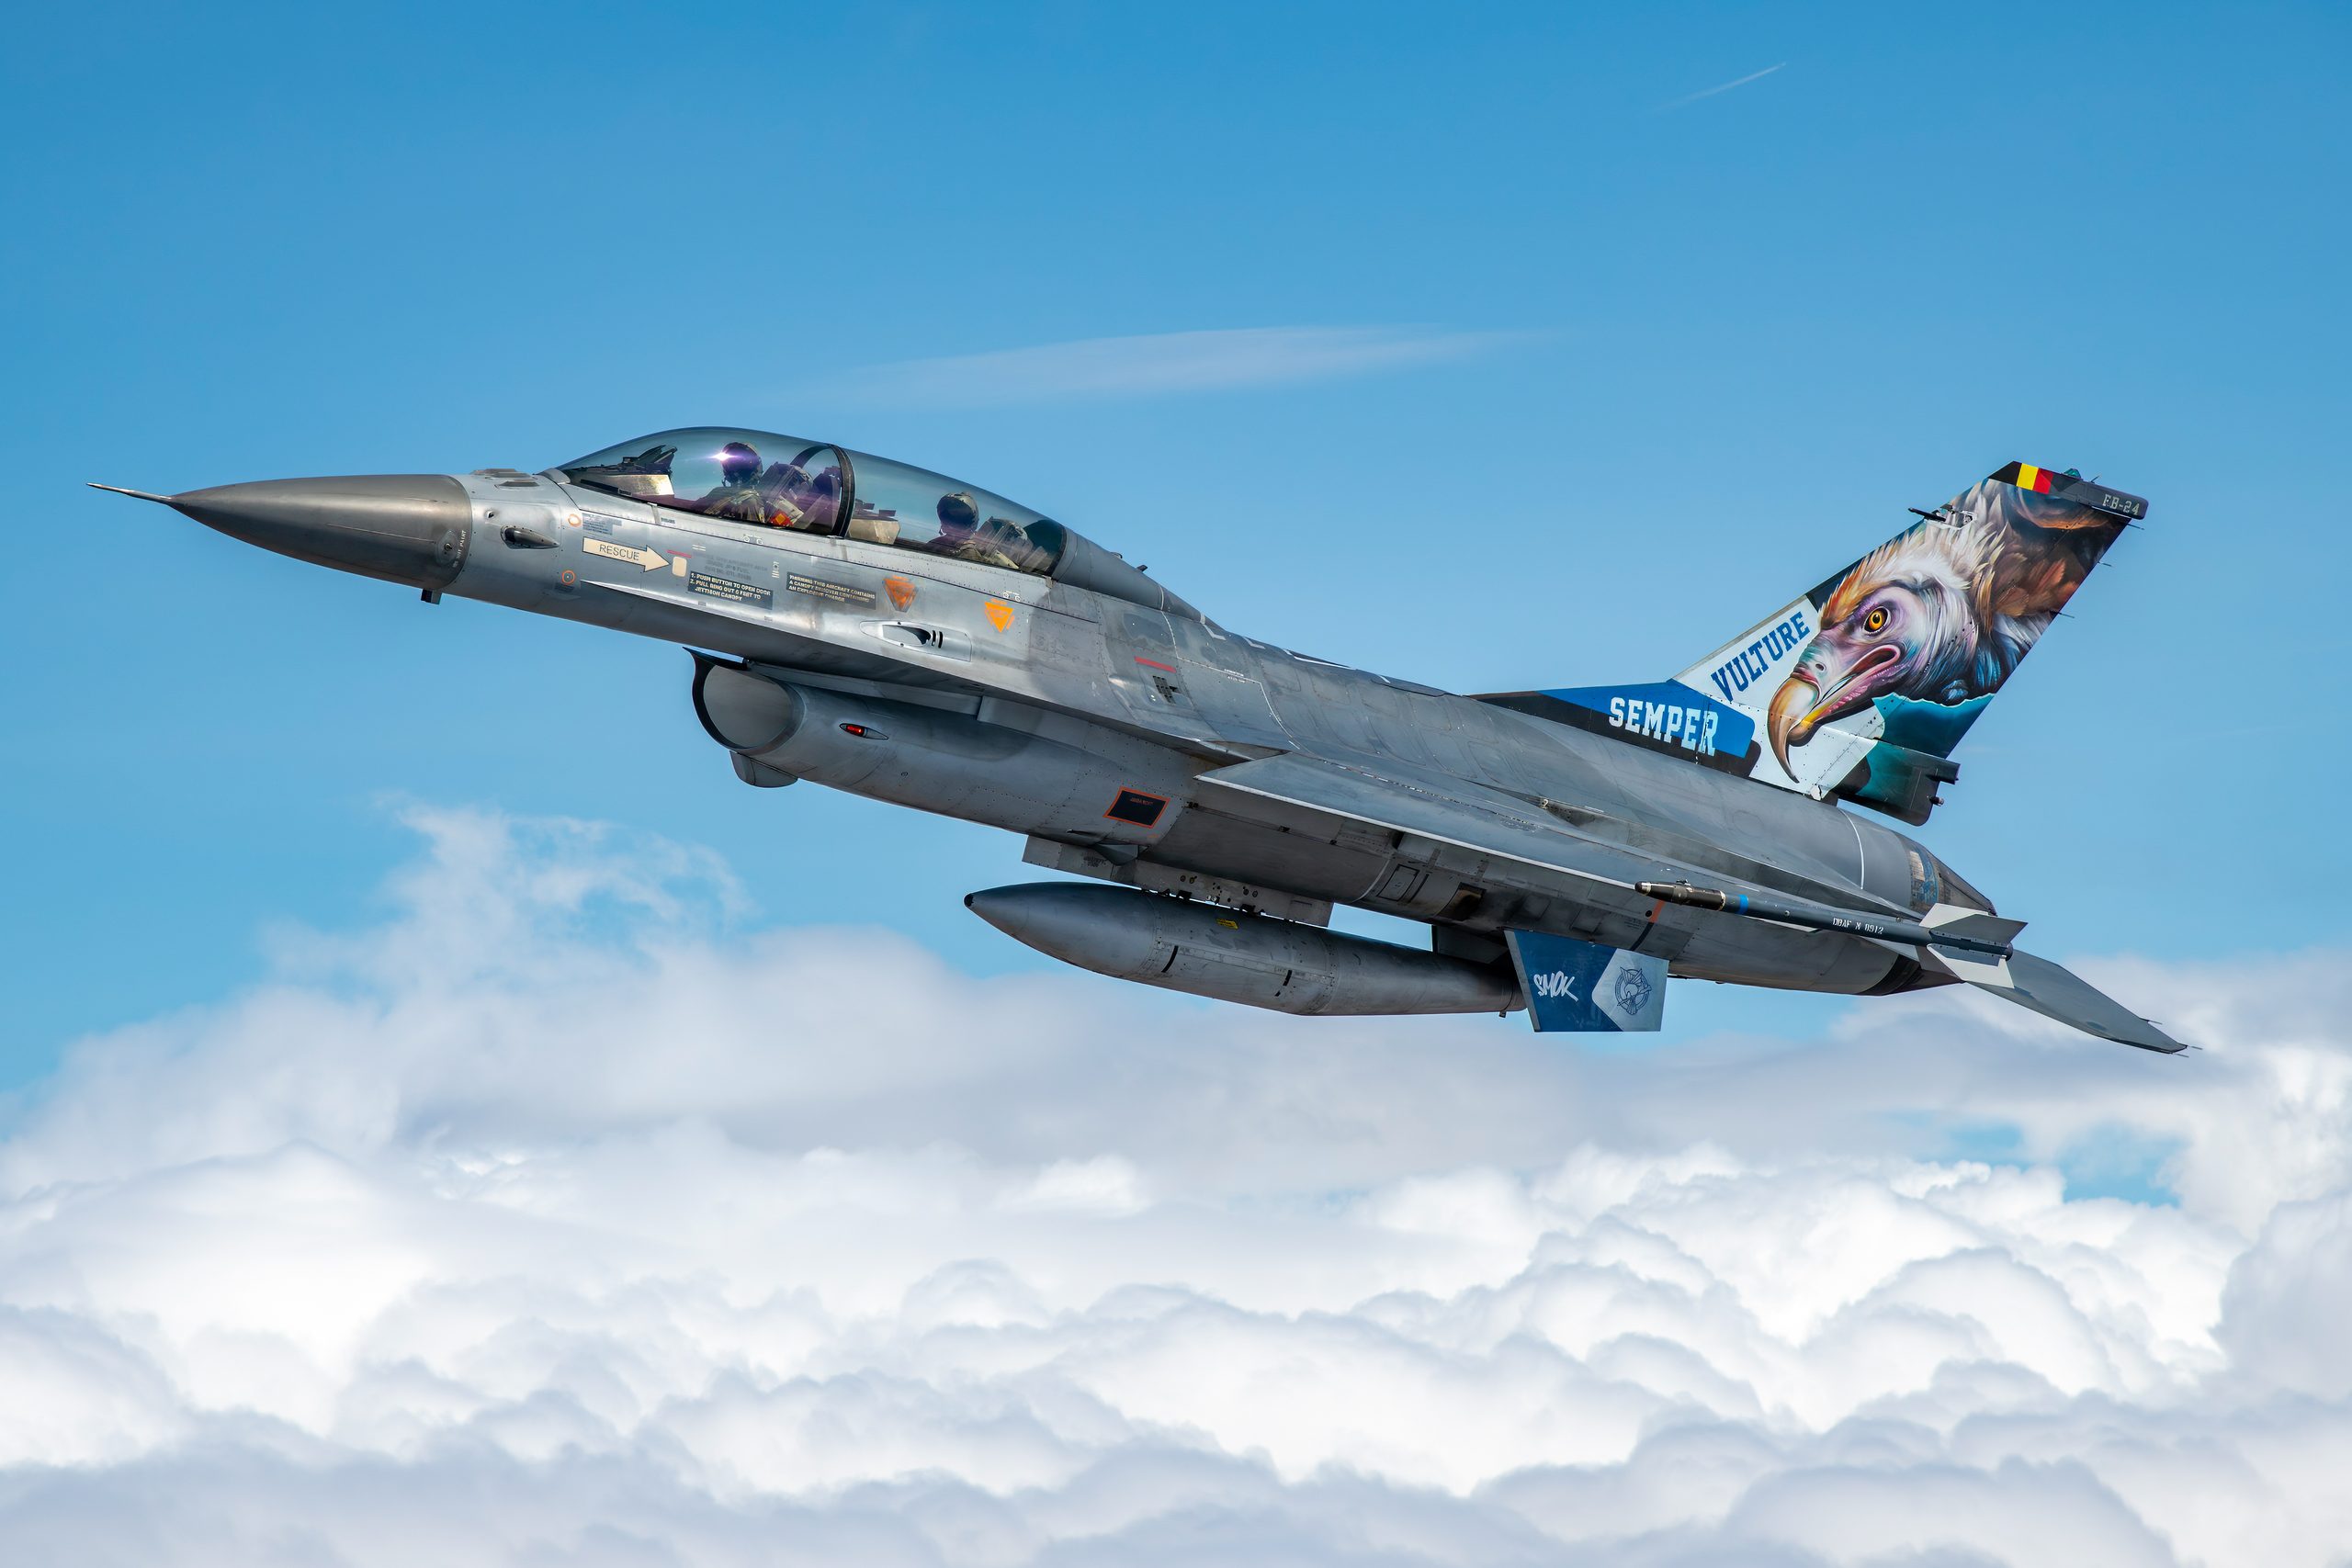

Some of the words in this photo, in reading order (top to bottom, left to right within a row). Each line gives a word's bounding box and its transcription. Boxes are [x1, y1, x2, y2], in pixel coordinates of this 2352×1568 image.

[599, 544, 639, 560] RESCUE
[695, 580, 708, 588] PULL
[712, 578, 732, 587] BUTTON
[741, 584, 755, 592] OPEN
[756, 588, 771, 596] DOOR
[794, 581, 814, 590] CANOPY
[814, 580, 825, 588] THIS
[826, 583, 850, 592] AIRCRAFT
[851, 589, 876, 600] CONTAINS
[695, 586, 720, 597] JETTISON
[721, 592, 742, 602] CANOPY
[1710, 611, 1811, 703] VULTURE
[1608, 696, 1719, 757] SEMPER
[1533, 970, 1579, 1002] SMOK
